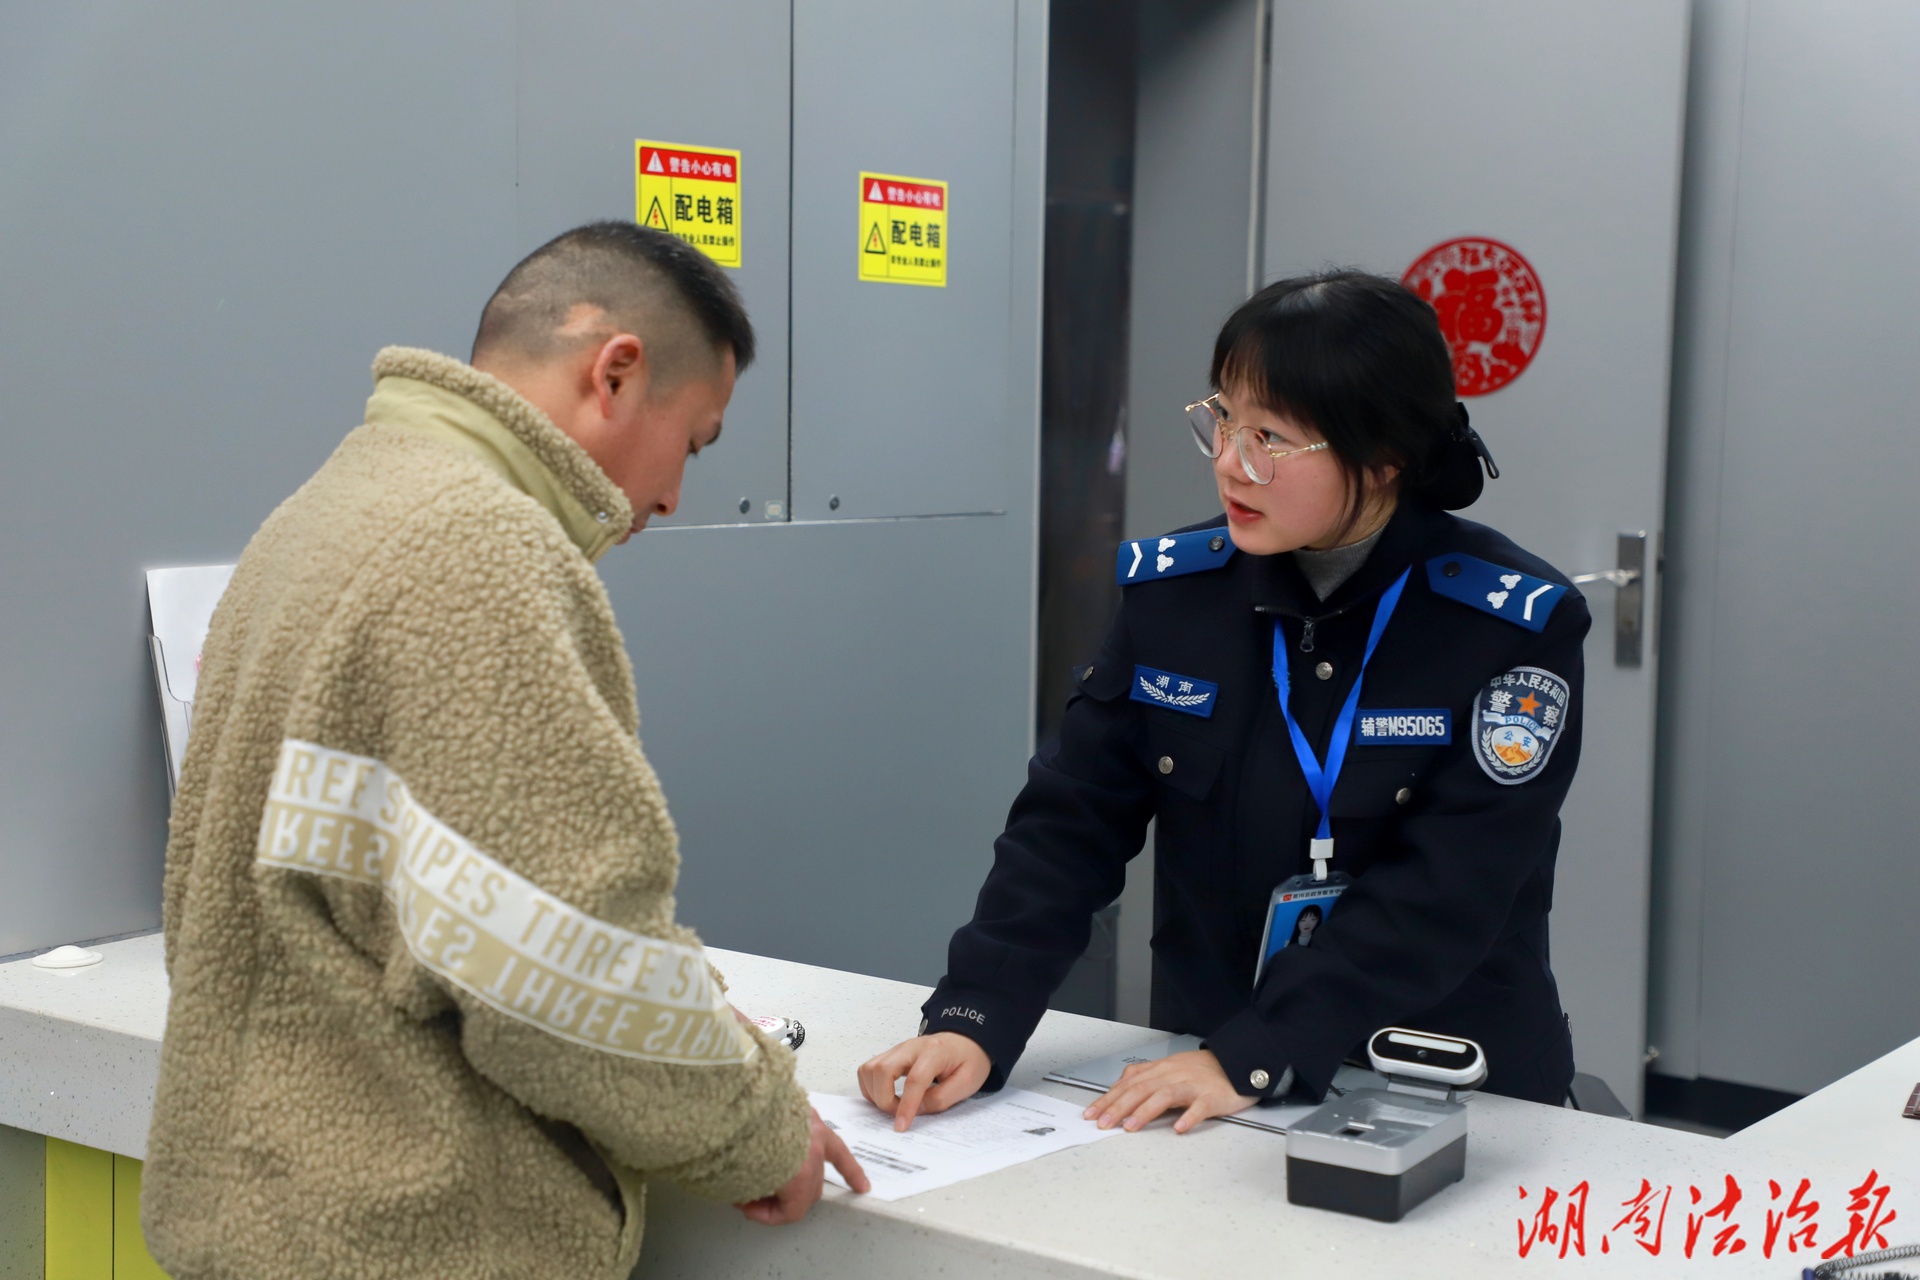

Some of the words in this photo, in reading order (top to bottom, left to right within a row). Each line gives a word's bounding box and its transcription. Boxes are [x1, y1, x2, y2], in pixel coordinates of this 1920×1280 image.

[669, 156, 733, 178] 警告小心有电
[886, 185, 941, 207] 警告小心有电
[674, 193, 734, 226] 配电箱
[891, 220, 941, 249] 配电箱
[1155, 675, 1194, 694] 湖南
[1490, 672, 1567, 708] 中华人民共和国
[1361, 715, 1446, 737] 辅警M95065
[1504, 715, 1540, 734] POLICE
[1503, 730, 1532, 748] 公安
[519, 898, 665, 994] THREE
[941, 1006, 985, 1025] POLICE
